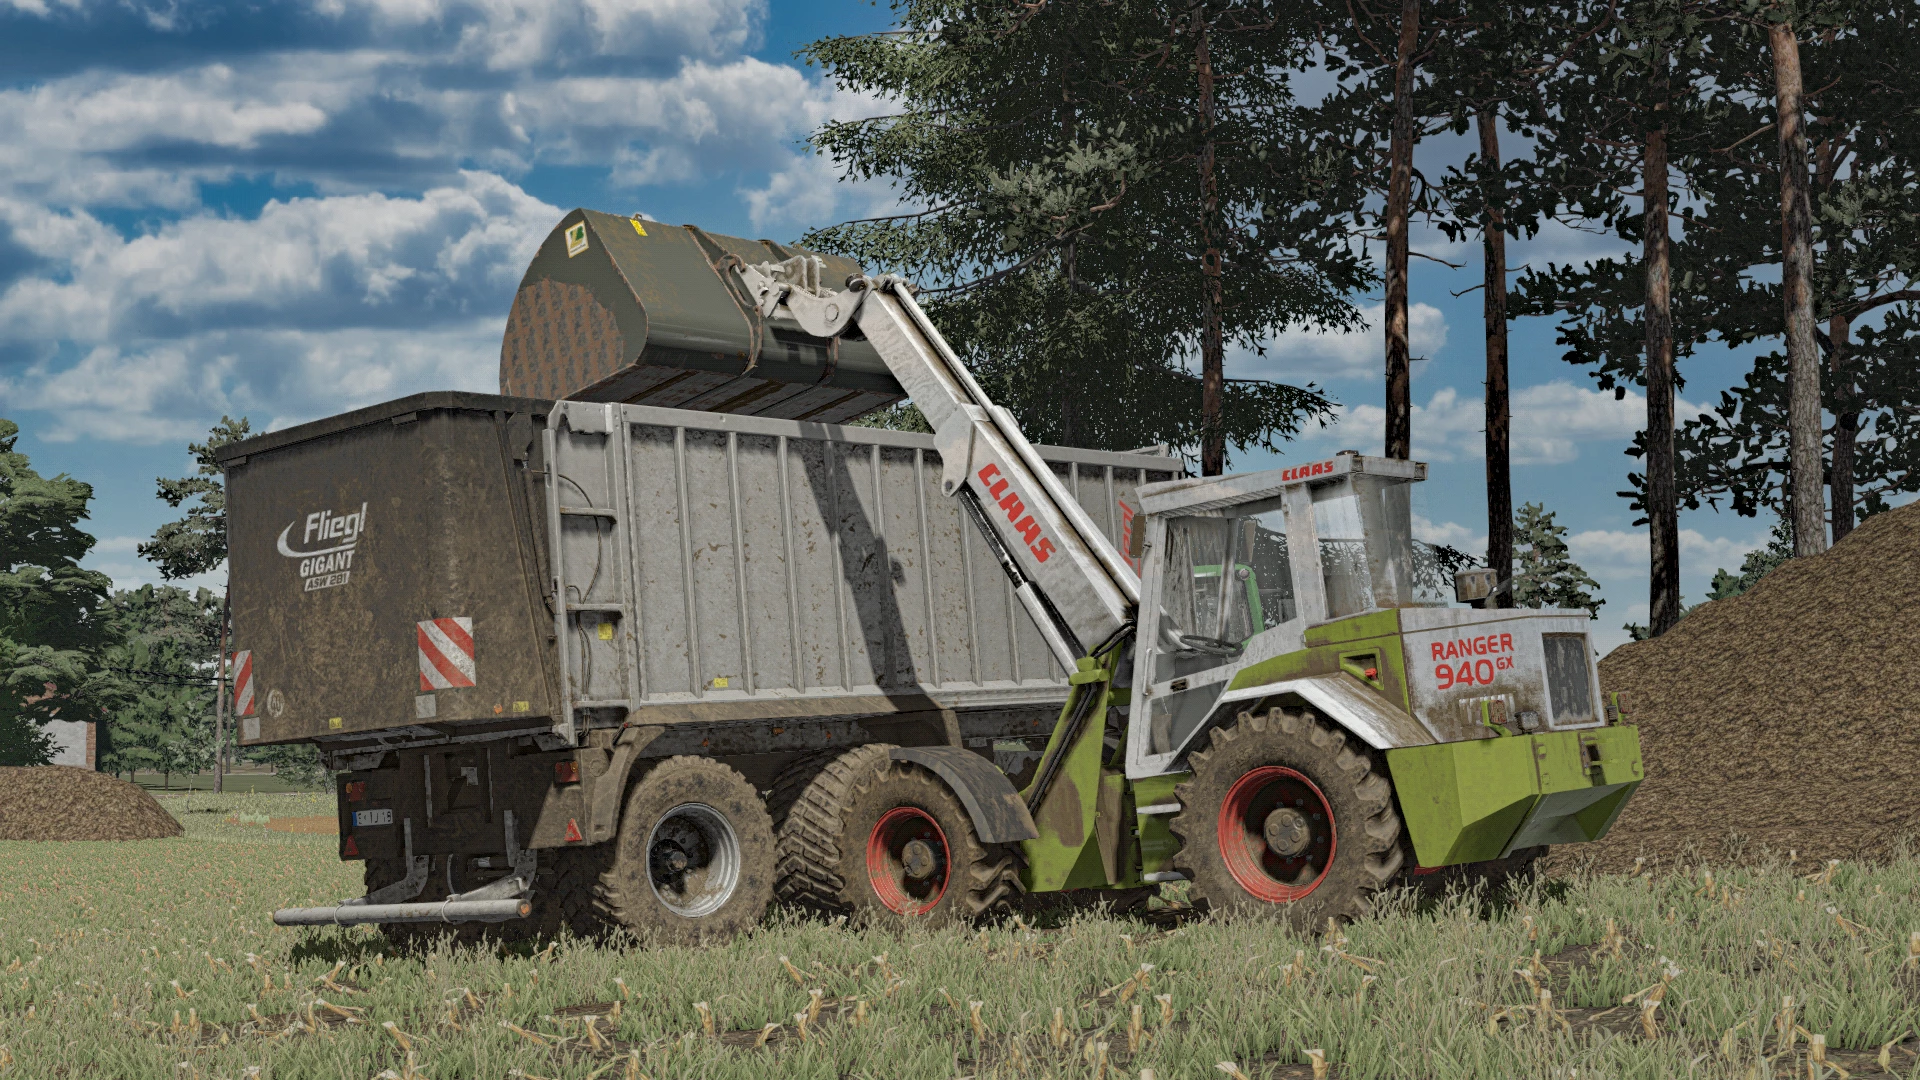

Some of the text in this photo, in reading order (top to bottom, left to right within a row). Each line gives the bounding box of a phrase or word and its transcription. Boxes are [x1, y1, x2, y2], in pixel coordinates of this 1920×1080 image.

[1282, 461, 1334, 481] CLAAS
[303, 502, 368, 545] Fliegl
[978, 463, 1056, 563] CLAAS
[300, 549, 356, 577] GIGANT
[307, 577, 329, 590] ASW
[1431, 633, 1515, 661] RANGER
[1435, 655, 1514, 690] 940 GX
